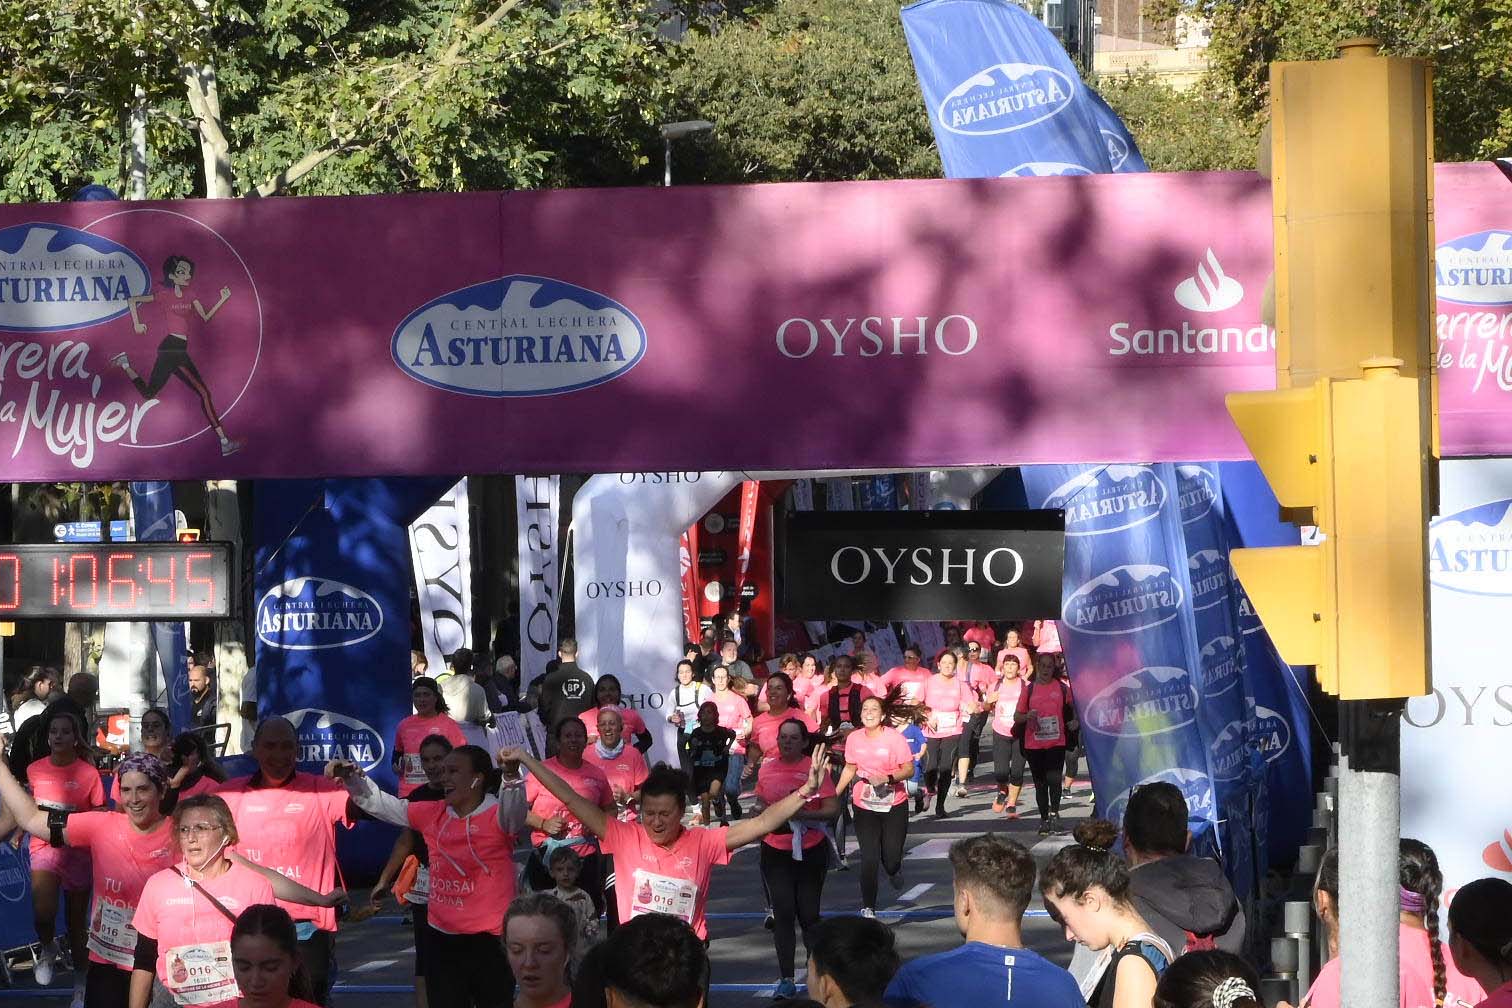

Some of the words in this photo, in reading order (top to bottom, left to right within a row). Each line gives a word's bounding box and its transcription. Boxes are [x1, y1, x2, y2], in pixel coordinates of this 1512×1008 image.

[50, 259, 126, 271] LECHERA
[450, 318, 529, 332] CENTRAL
[537, 315, 618, 329] LECHERA
[411, 321, 627, 369] ASTURIANA
[775, 313, 979, 360] OYSHO
[11, 376, 160, 470] Mujer
[830, 545, 1024, 588] OYSHO
[586, 579, 663, 600] OYSHO
[261, 605, 374, 634] ASTURIANA
[567, 683, 580, 692] BP
[105, 877, 121, 893] TU
[654, 895, 673, 906] 016
[101, 925, 119, 936] 016
[190, 965, 211, 976] 016
